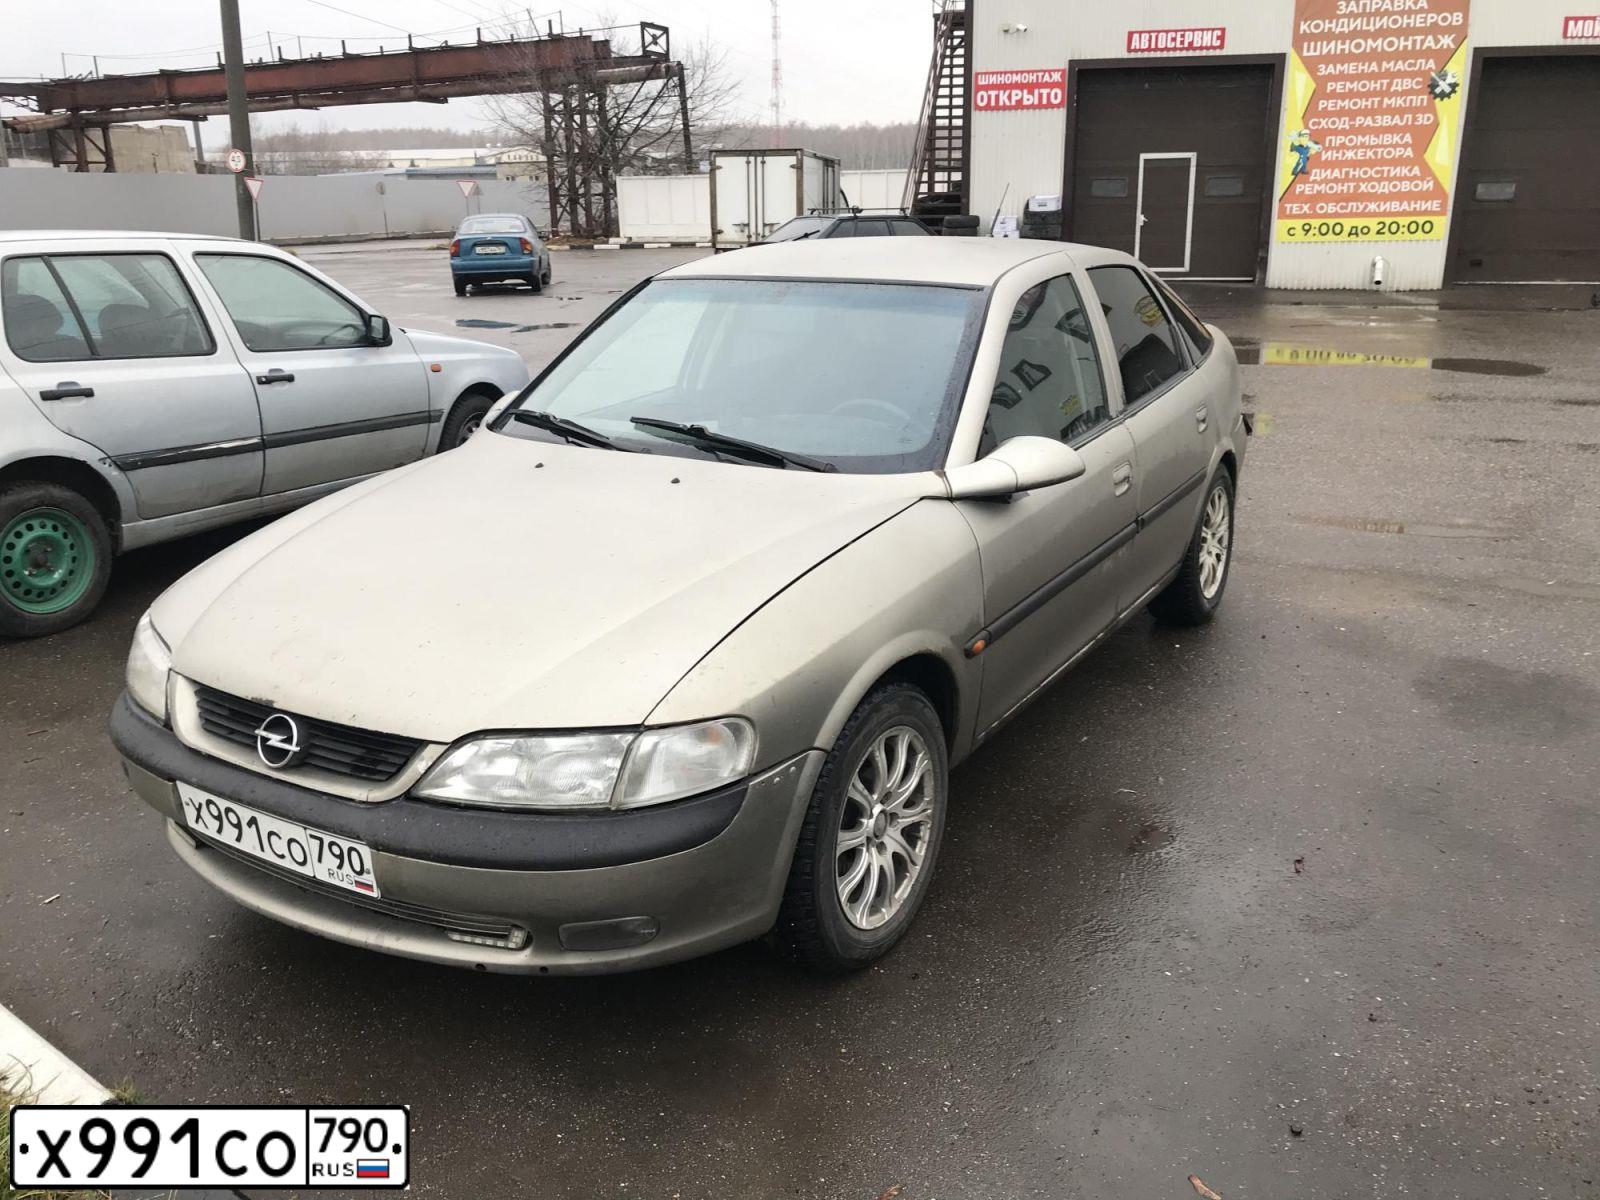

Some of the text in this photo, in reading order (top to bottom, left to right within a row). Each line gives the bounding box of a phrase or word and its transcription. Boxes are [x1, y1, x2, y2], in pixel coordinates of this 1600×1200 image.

[1335, 0, 1429, 15] ЗАПРАВКА
[1299, 12, 1464, 34] КОНДИЦИОНЕРОВ
[1130, 29, 1222, 50] АВТОСЕРВИС
[1302, 34, 1456, 57] ШИНОМОНТАЖ
[1316, 58, 1436, 76] ЗАМЕНА МАСЛА
[977, 71, 1062, 86] ШИНОМОНТАЖ
[1326, 77, 1424, 94] РЕМОНТ ДВС
[976, 88, 1062, 107] ОТКРЫТО
[1318, 95, 1428, 111] РЕМОНТ МКПП
[1308, 113, 1434, 131] СХОД-РАЗВАЛ 3D
[1325, 133, 1413, 148] ПРОМЫВКА
[1321, 147, 1414, 162] ИНЖЕКТОРА
[1309, 165, 1421, 181] ДИАГНОСТИКА
[1295, 179, 1435, 196] РЕМОНТ ХОДОВОЙ
[1285, 199, 1442, 215] ТЕХ. ОБСЛУЖИВАНИЕ
[1301, 222, 1344, 237] 9:00
[1347, 224, 1371, 239] до
[1375, 220, 1434, 236] 20:00
[309, 833, 365, 876] 790
[327, 868, 354, 886] RUS
